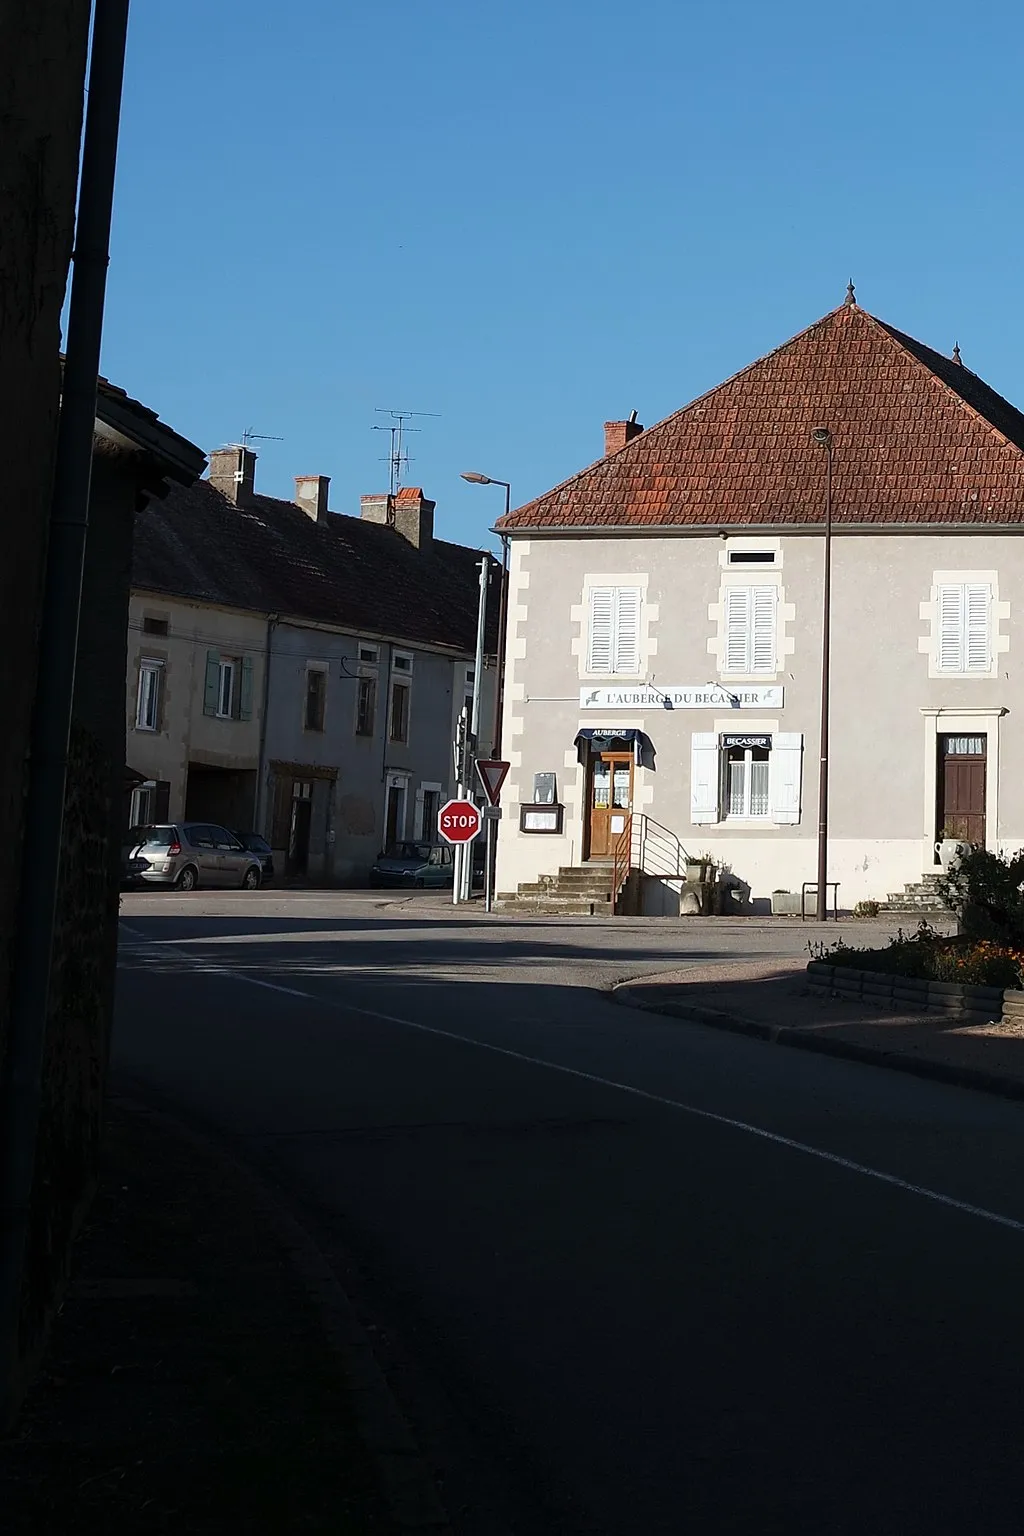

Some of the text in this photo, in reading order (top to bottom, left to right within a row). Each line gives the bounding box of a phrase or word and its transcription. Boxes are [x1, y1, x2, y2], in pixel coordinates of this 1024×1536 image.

[674, 693, 692, 704] DU
[695, 693, 759, 704] BECASIER
[726, 737, 767, 745] BECASSIER
[443, 815, 477, 828] STOP
